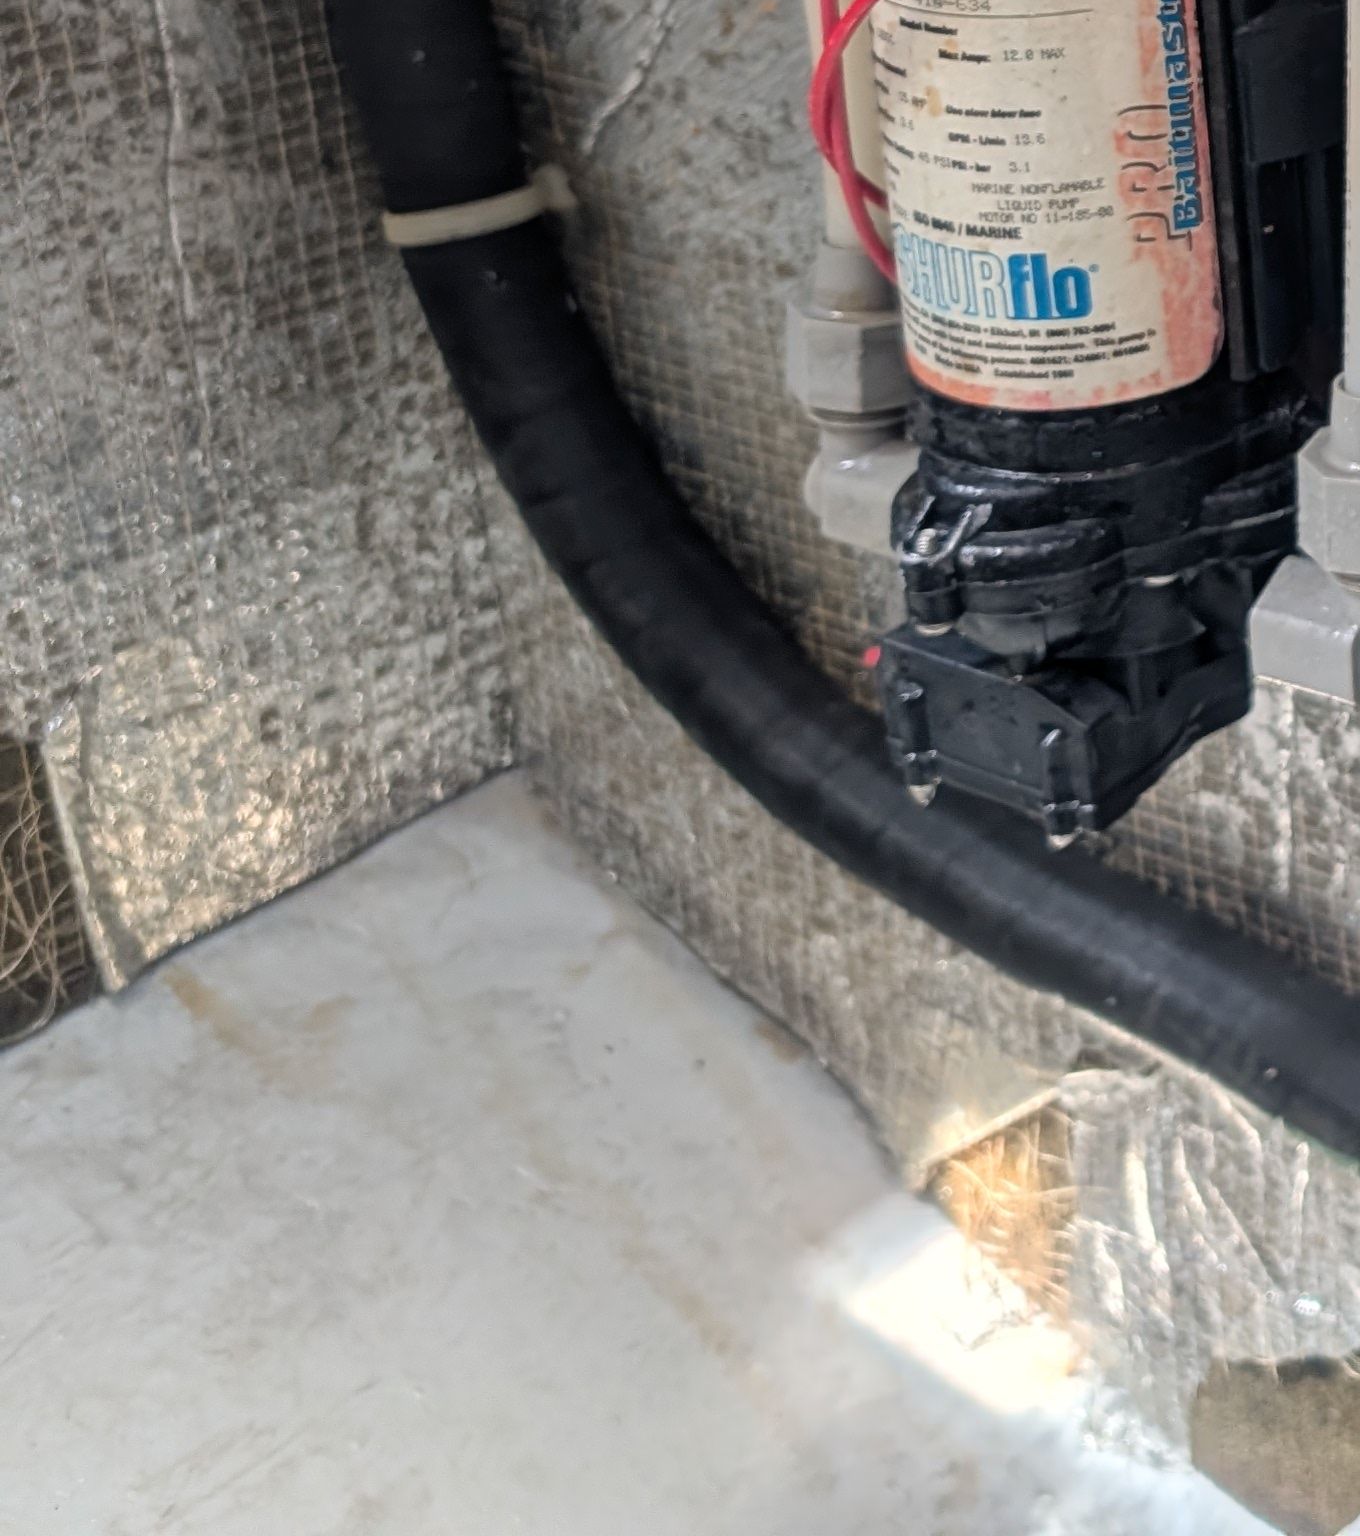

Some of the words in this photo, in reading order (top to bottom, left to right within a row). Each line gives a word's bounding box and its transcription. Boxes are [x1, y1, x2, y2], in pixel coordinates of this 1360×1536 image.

[972, 183, 1014, 194] MARINE
[997, 199, 1042, 211] LIQUID
[1048, 198, 1080, 210] PUMP
[966, 225, 1022, 239] MARINE
